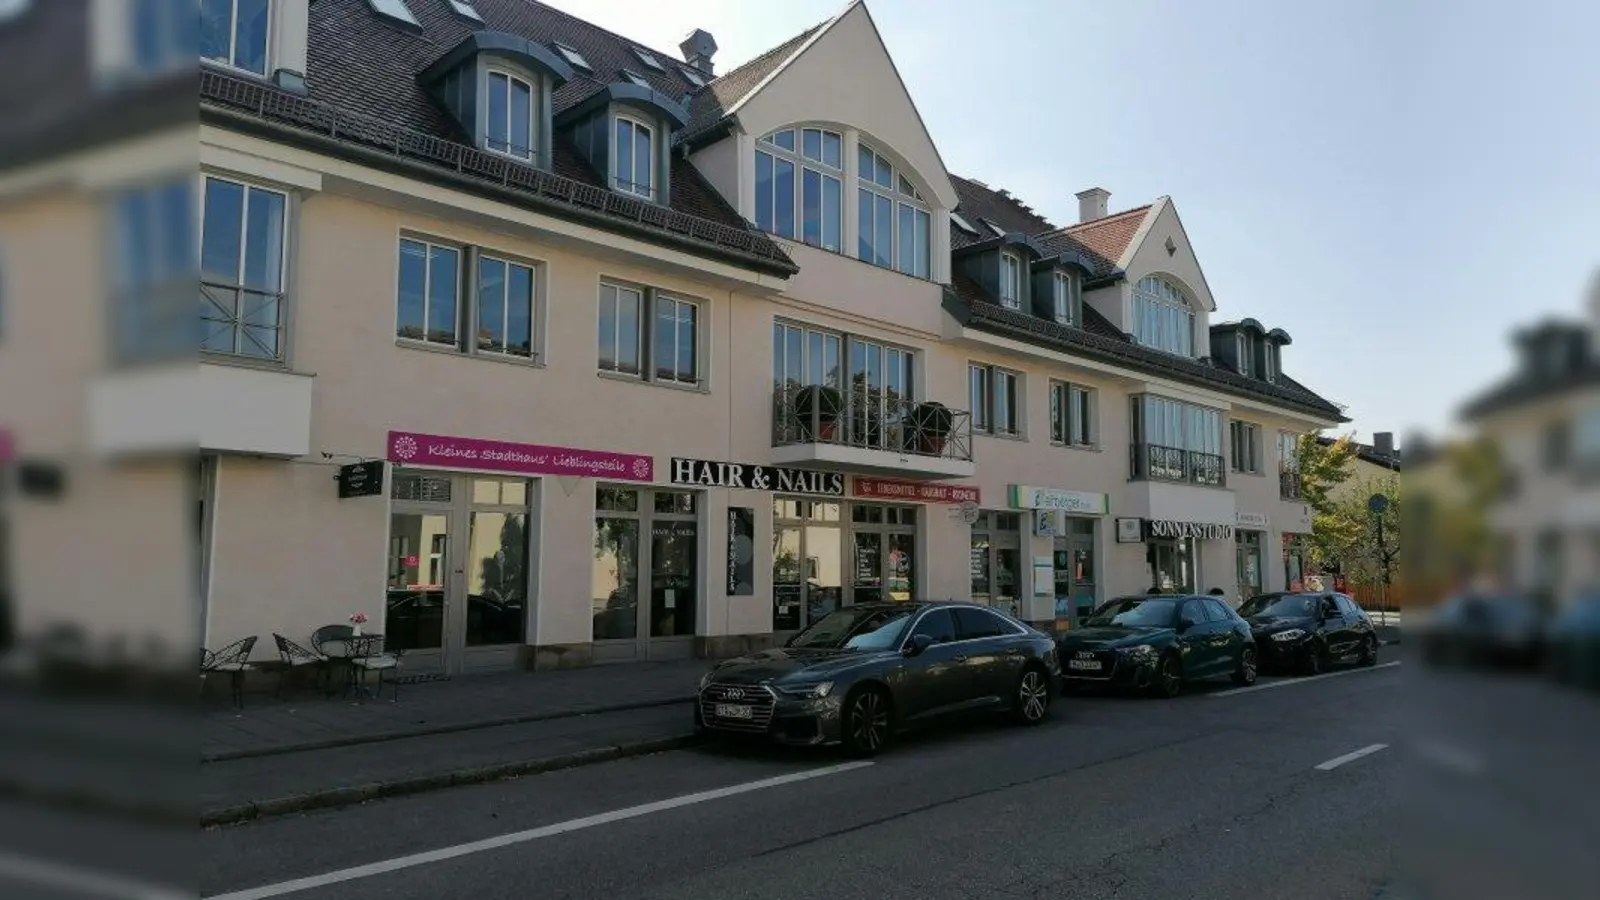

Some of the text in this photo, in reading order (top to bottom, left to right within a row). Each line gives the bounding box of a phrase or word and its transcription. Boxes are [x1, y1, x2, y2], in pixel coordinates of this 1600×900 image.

[428, 444, 477, 459] Kleines
[553, 455, 625, 473] Lieblingsteile
[673, 458, 843, 495] HAIR & NAILS
[1151, 519, 1234, 540] SONNENSTUDIO
